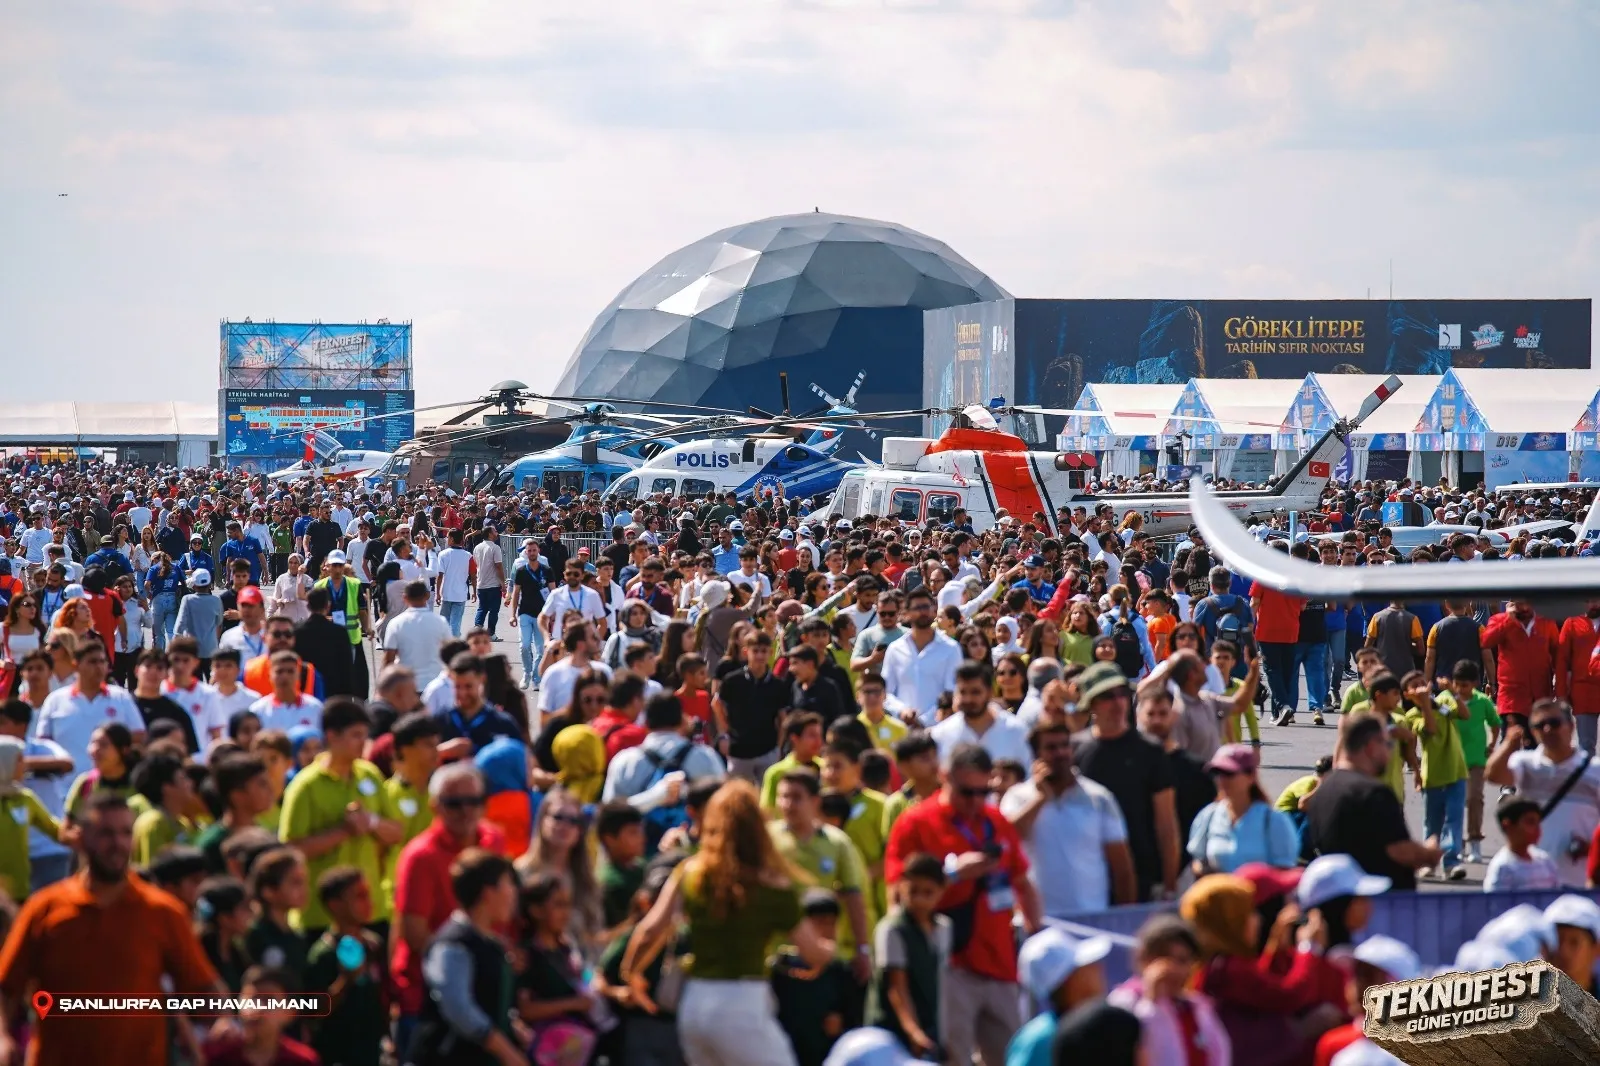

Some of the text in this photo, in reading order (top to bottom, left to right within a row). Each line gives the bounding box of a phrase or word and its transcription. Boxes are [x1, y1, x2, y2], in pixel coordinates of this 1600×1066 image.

[1224, 316, 1365, 340] GÖBEKLİTEPE
[1225, 340, 1365, 354] TARİHİN SIFIR NOKTASI
[1496, 435, 1519, 448] D16
[676, 451, 729, 468] POLİS
